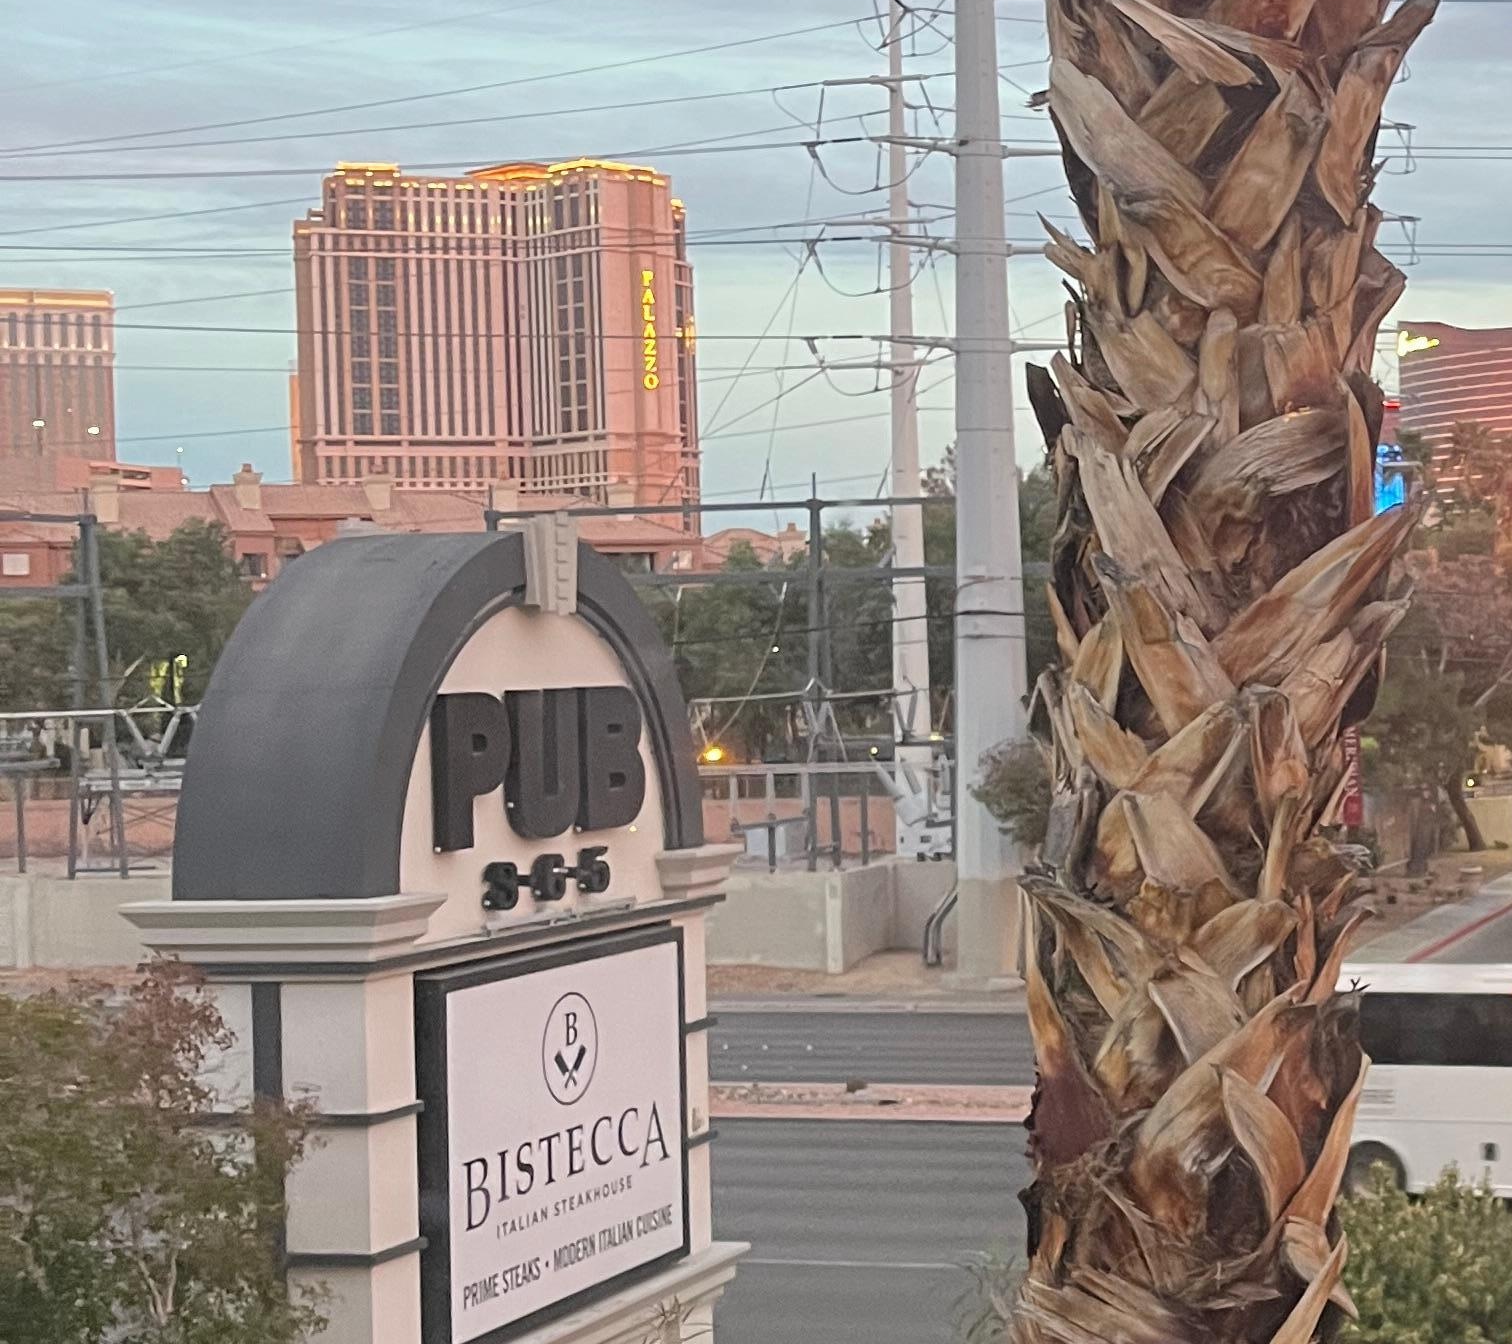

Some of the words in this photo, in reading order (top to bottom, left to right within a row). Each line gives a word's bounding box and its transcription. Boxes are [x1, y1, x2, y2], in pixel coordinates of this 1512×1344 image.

[641, 269, 660, 390] PALAZZO
[429, 686, 646, 854] PUB
[565, 1011, 578, 1046] B
[462, 1100, 671, 1232] BISTECCA
[496, 1205, 549, 1239] ITALIAN
[553, 1174, 633, 1217] STEAKHOUSE
[463, 1273, 500, 1310] PRIME
[502, 1257, 542, 1295] STEAKS
[553, 1232, 597, 1272] MODERN
[598, 1219, 635, 1254] ITALIAN
[636, 1204, 673, 1238] CUISINE
